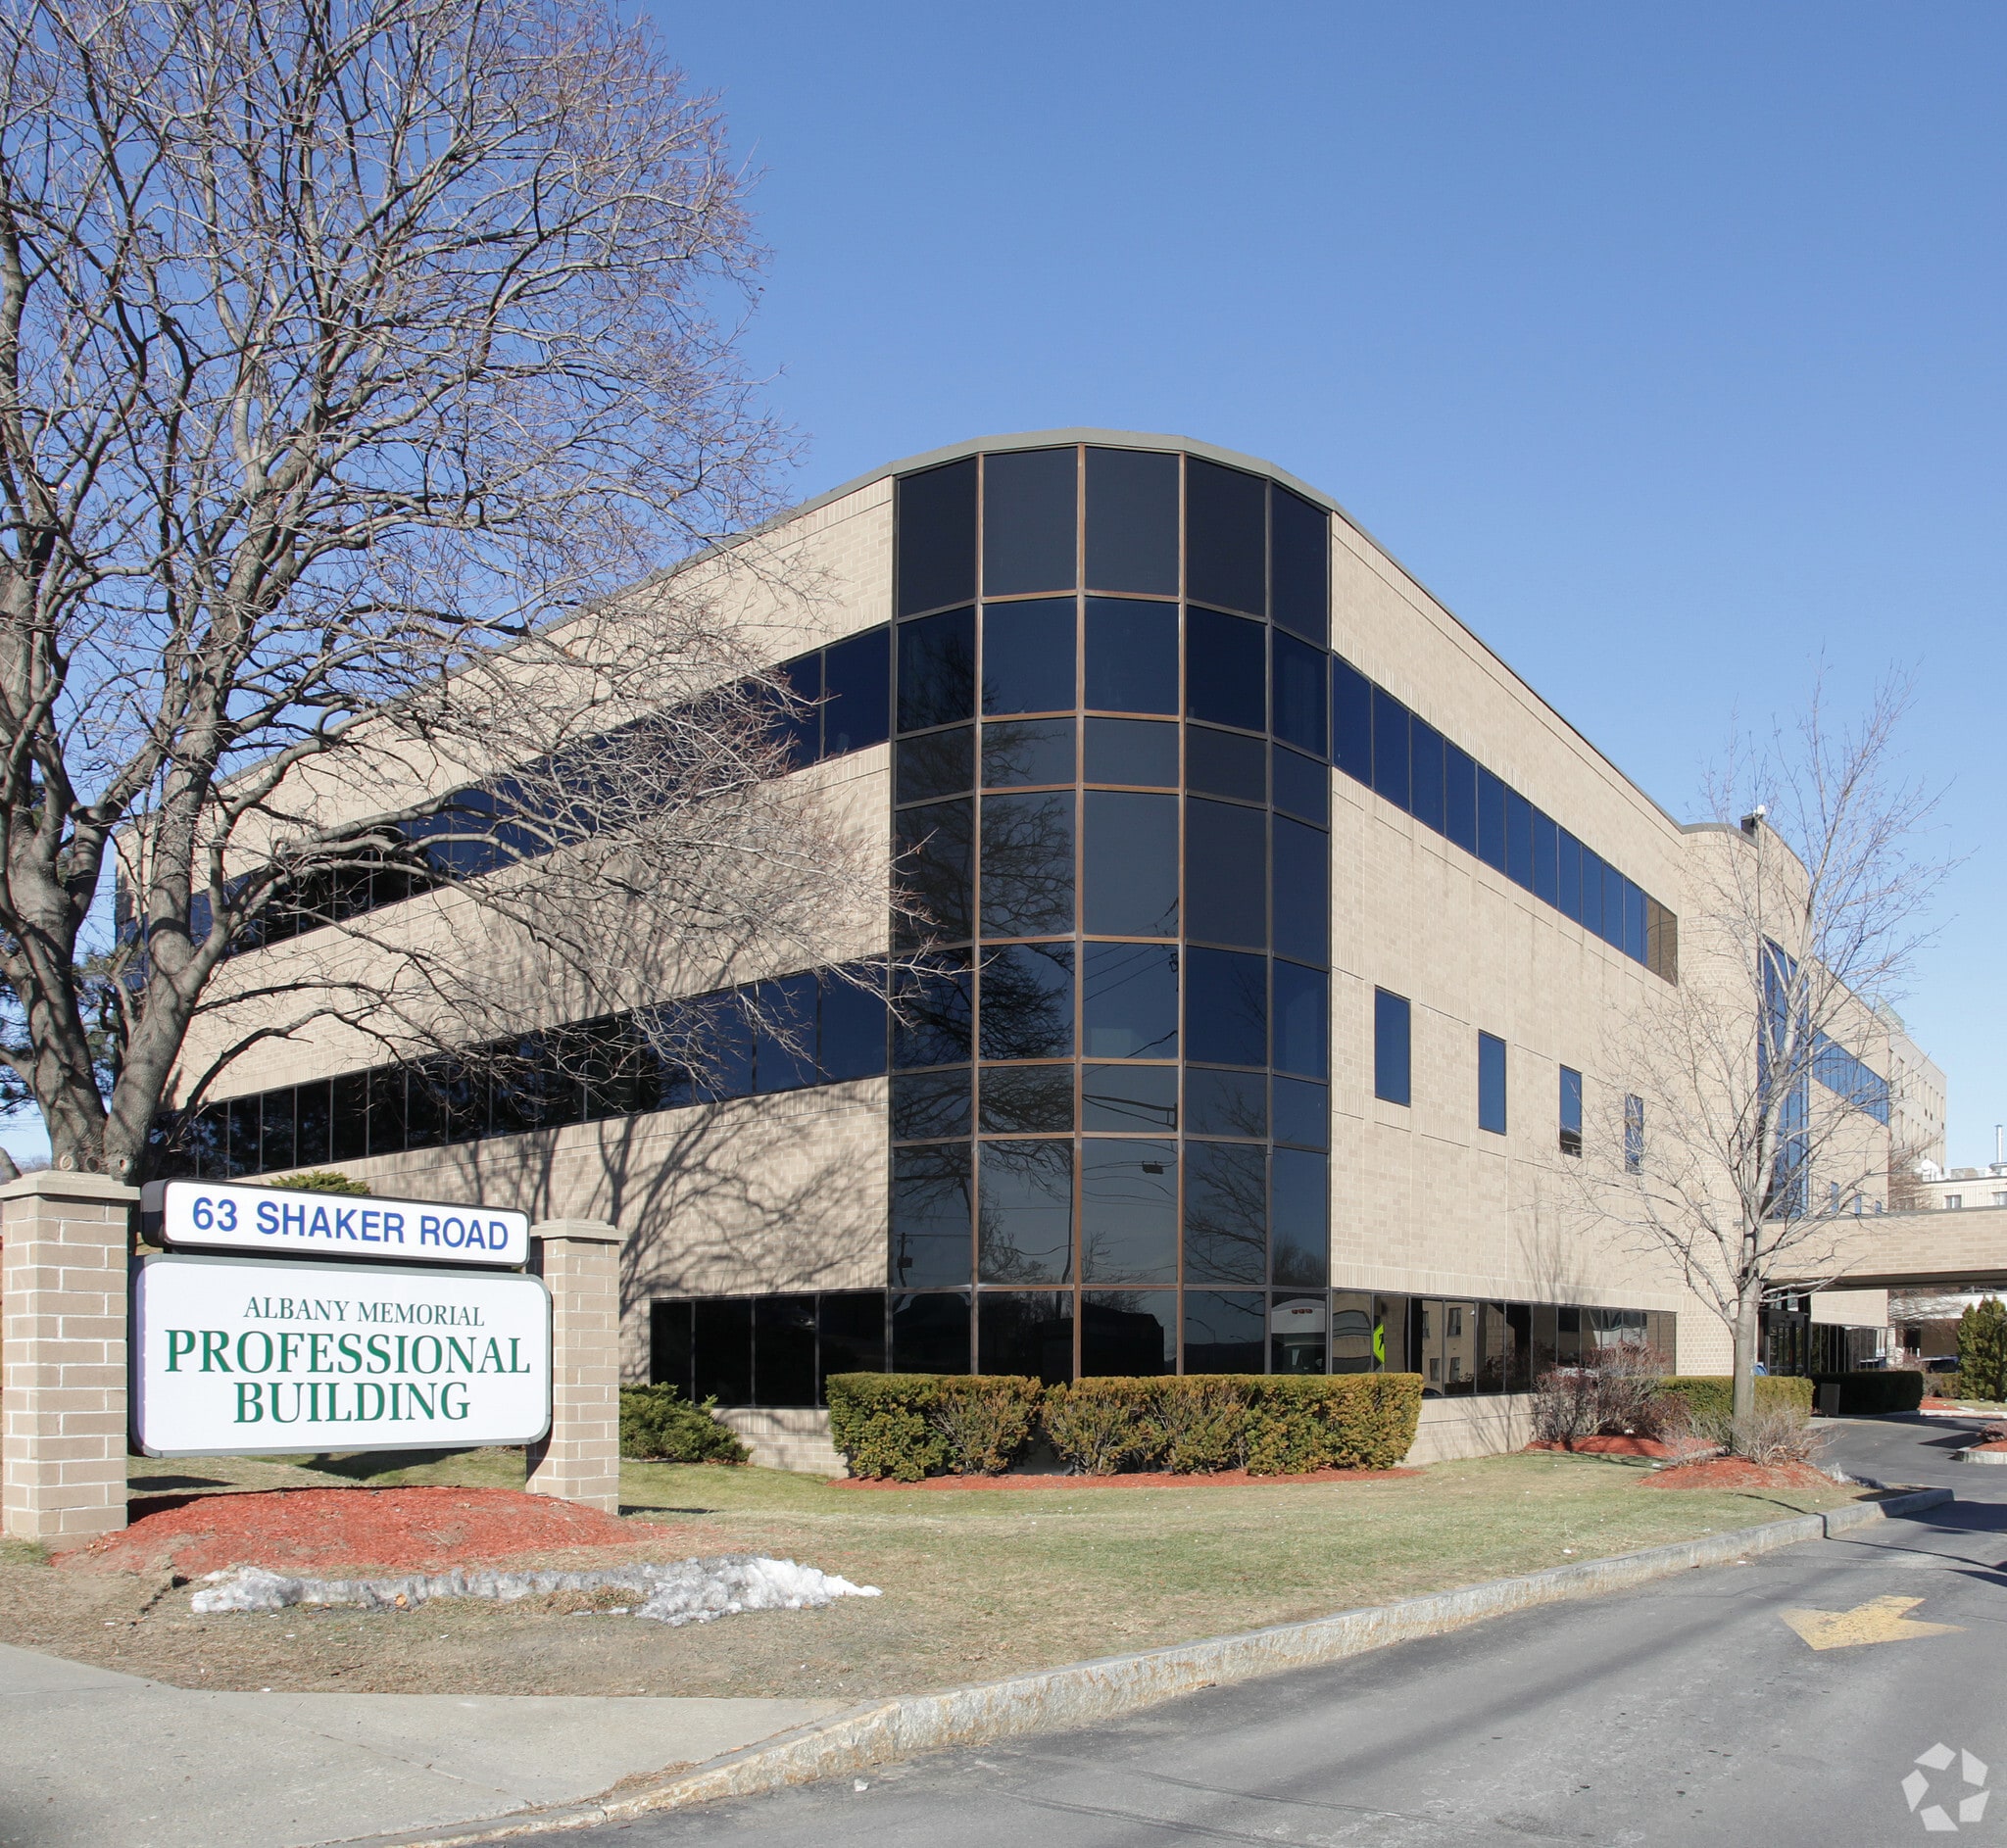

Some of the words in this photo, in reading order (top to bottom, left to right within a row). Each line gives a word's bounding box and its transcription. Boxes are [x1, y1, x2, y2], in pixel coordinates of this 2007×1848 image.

[192, 1197, 238, 1232] 63
[256, 1200, 405, 1243] SHAKER
[419, 1215, 509, 1249] ROAD
[243, 1296, 350, 1322] ALBANY
[358, 1301, 485, 1327] MEMORIAL
[164, 1329, 531, 1374] PROFESSIONAL
[233, 1382, 471, 1424] BUILDING
